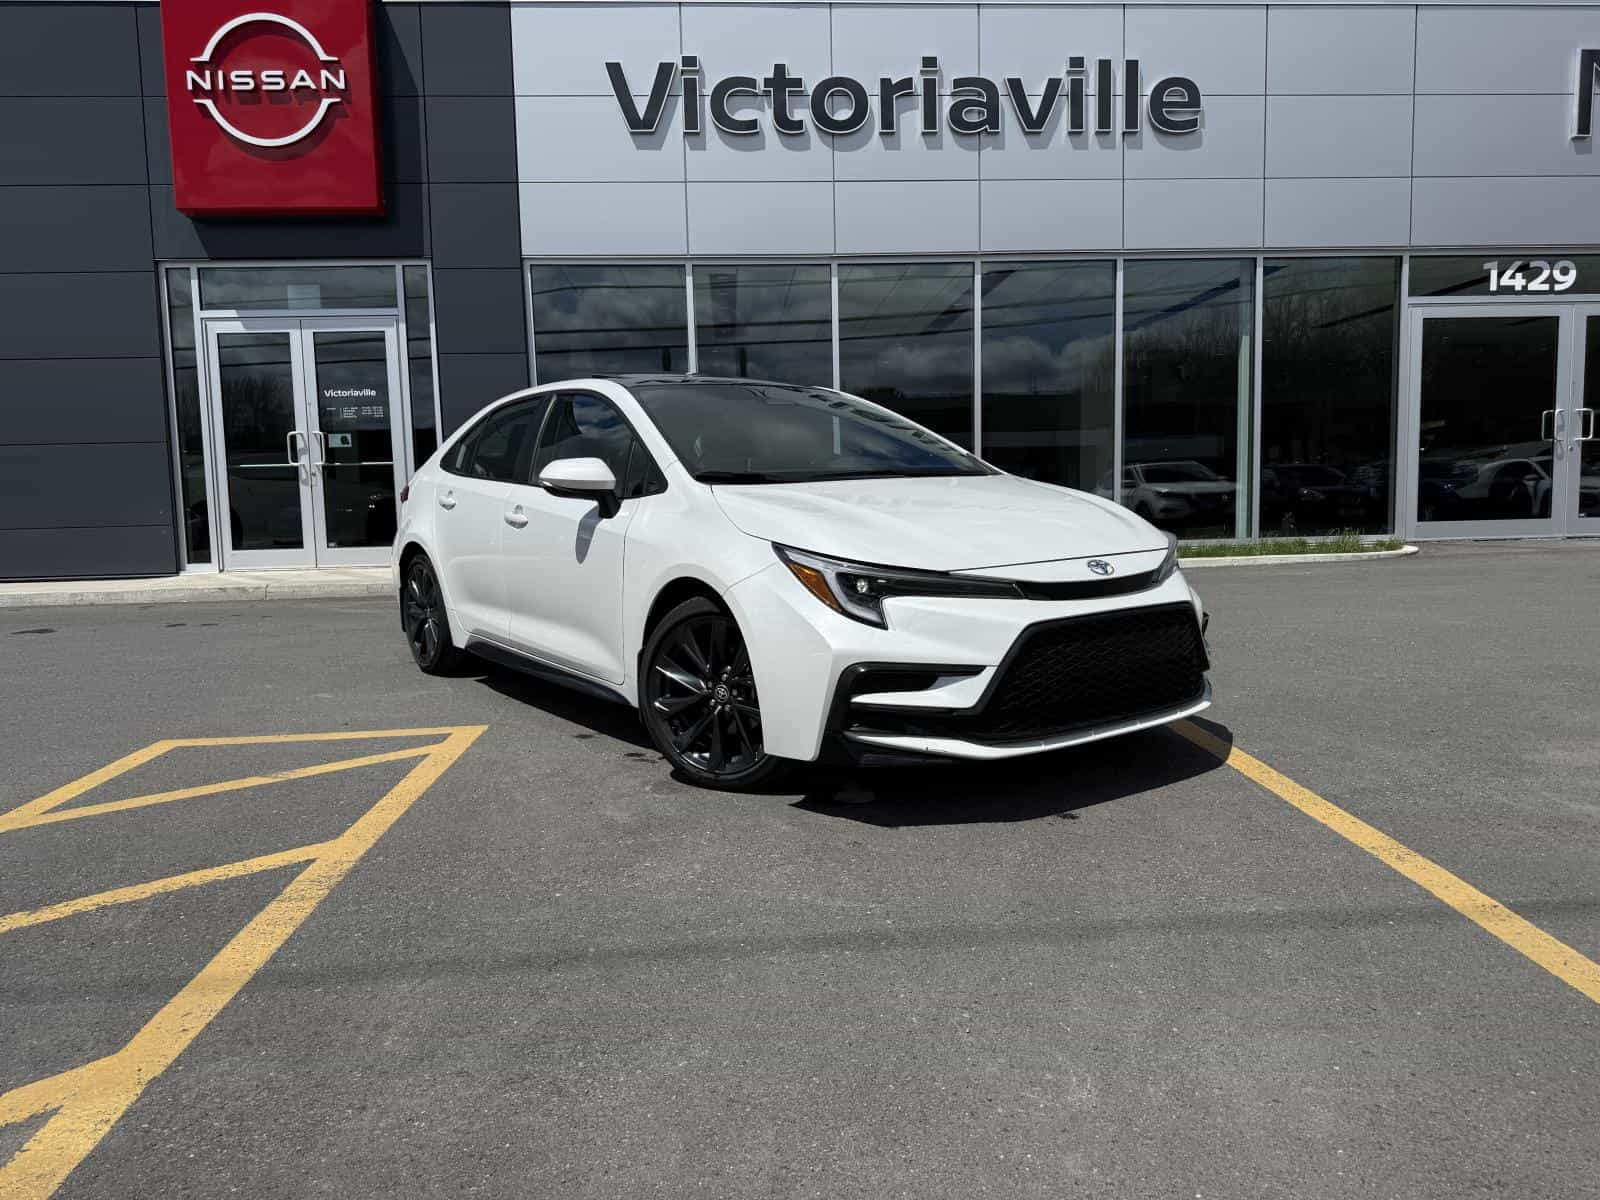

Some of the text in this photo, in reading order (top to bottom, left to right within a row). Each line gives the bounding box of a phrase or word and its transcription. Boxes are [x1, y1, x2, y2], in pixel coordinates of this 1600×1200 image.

[186, 69, 346, 91] NISSAN
[605, 55, 1203, 136] Victoriaville
[1483, 260, 1577, 291] 1429
[323, 388, 377, 398] Victoriaville
